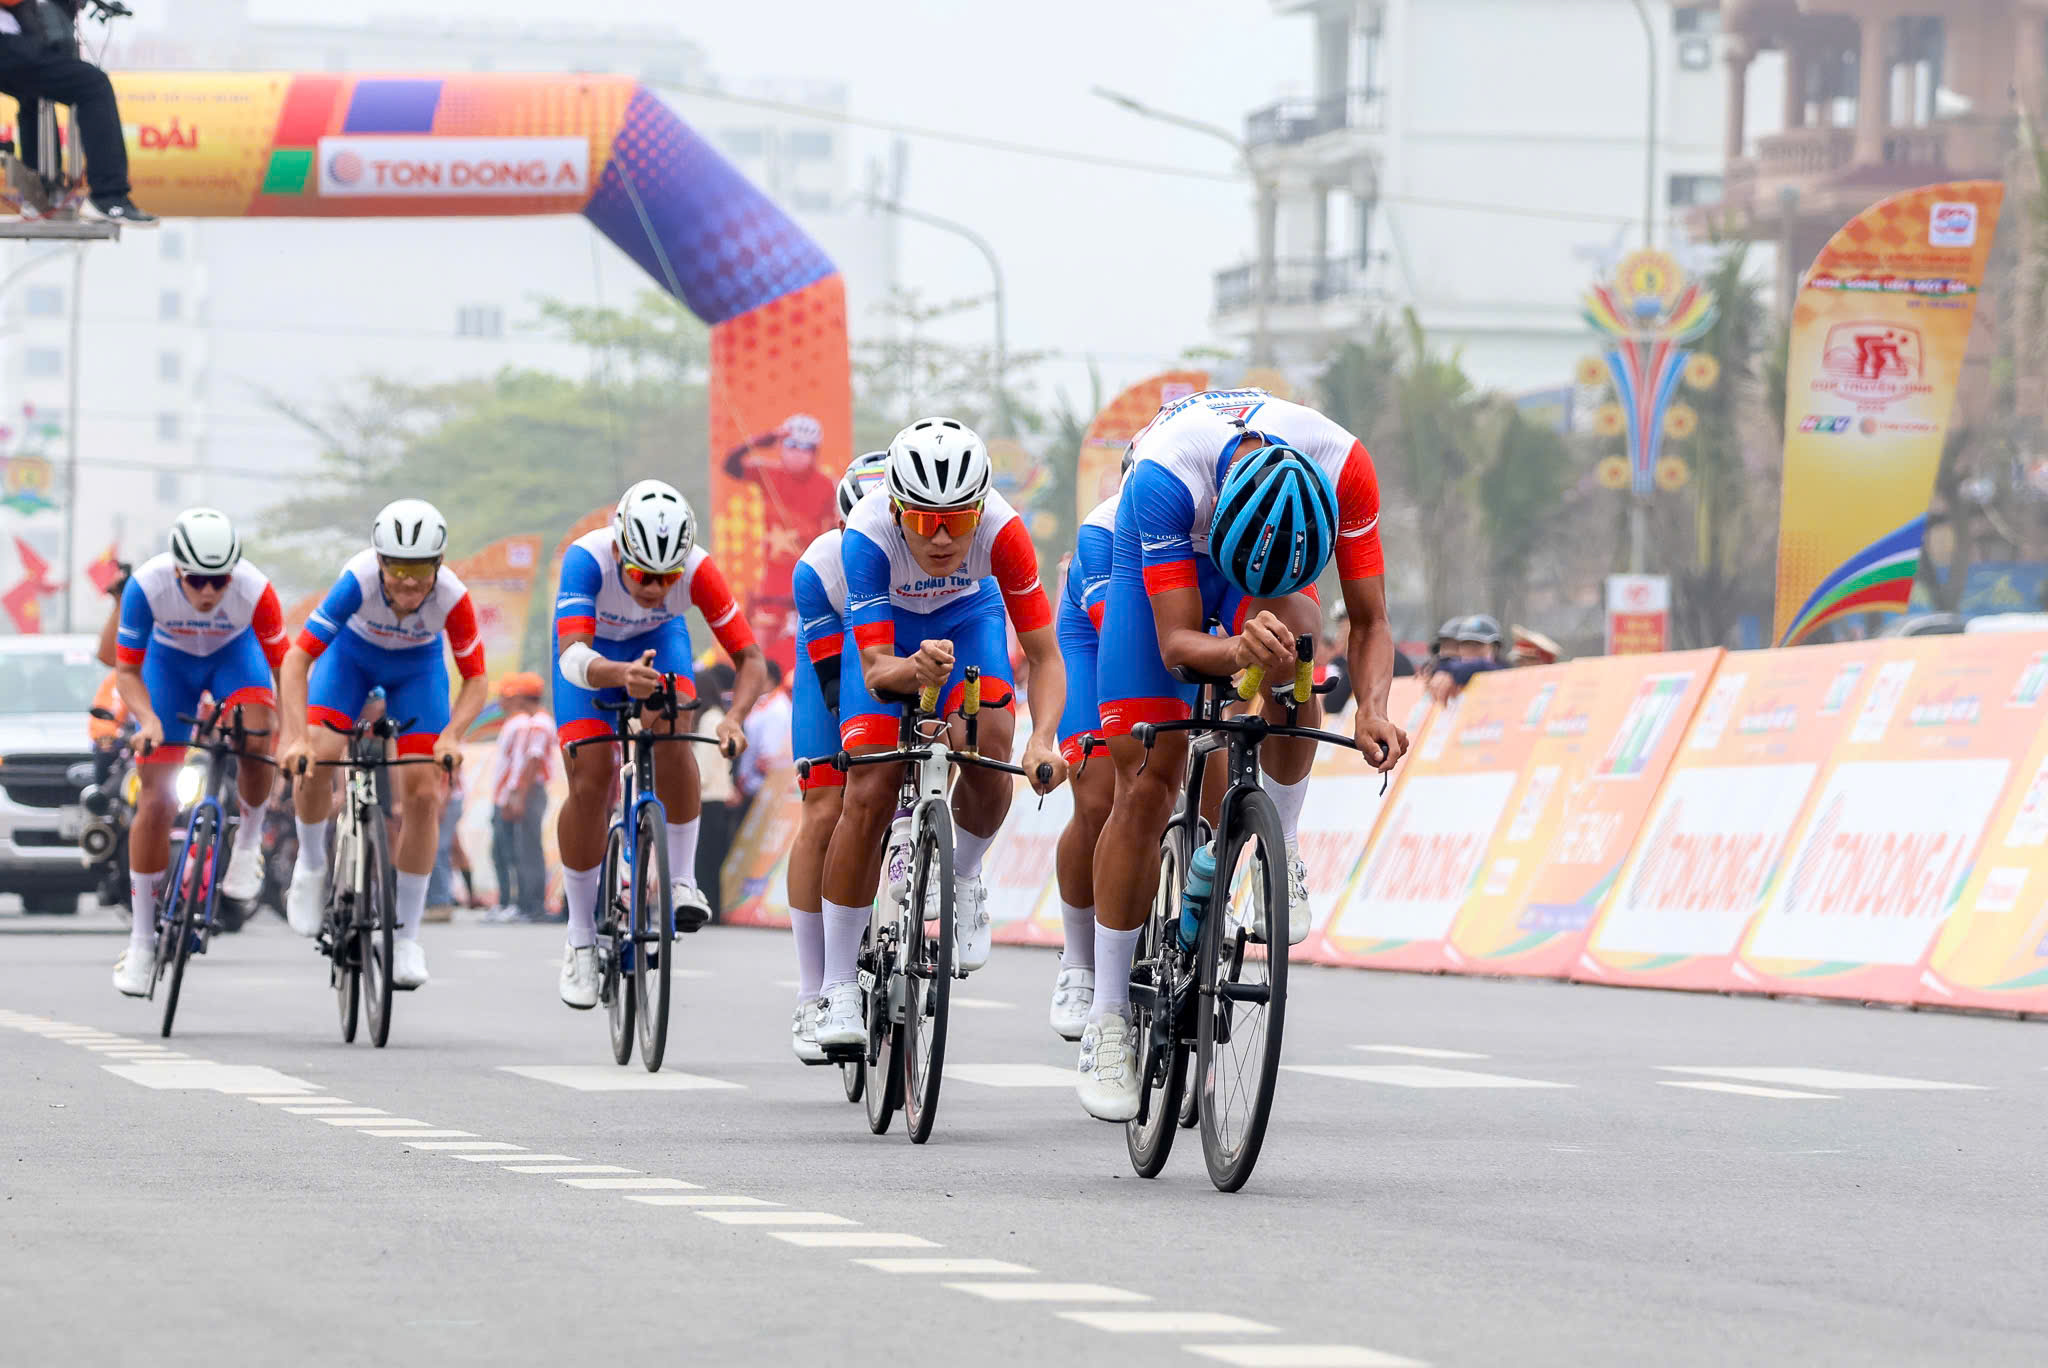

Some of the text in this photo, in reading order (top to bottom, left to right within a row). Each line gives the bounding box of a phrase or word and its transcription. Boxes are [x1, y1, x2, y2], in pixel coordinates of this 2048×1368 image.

[372, 160, 577, 187] TON DONG A
